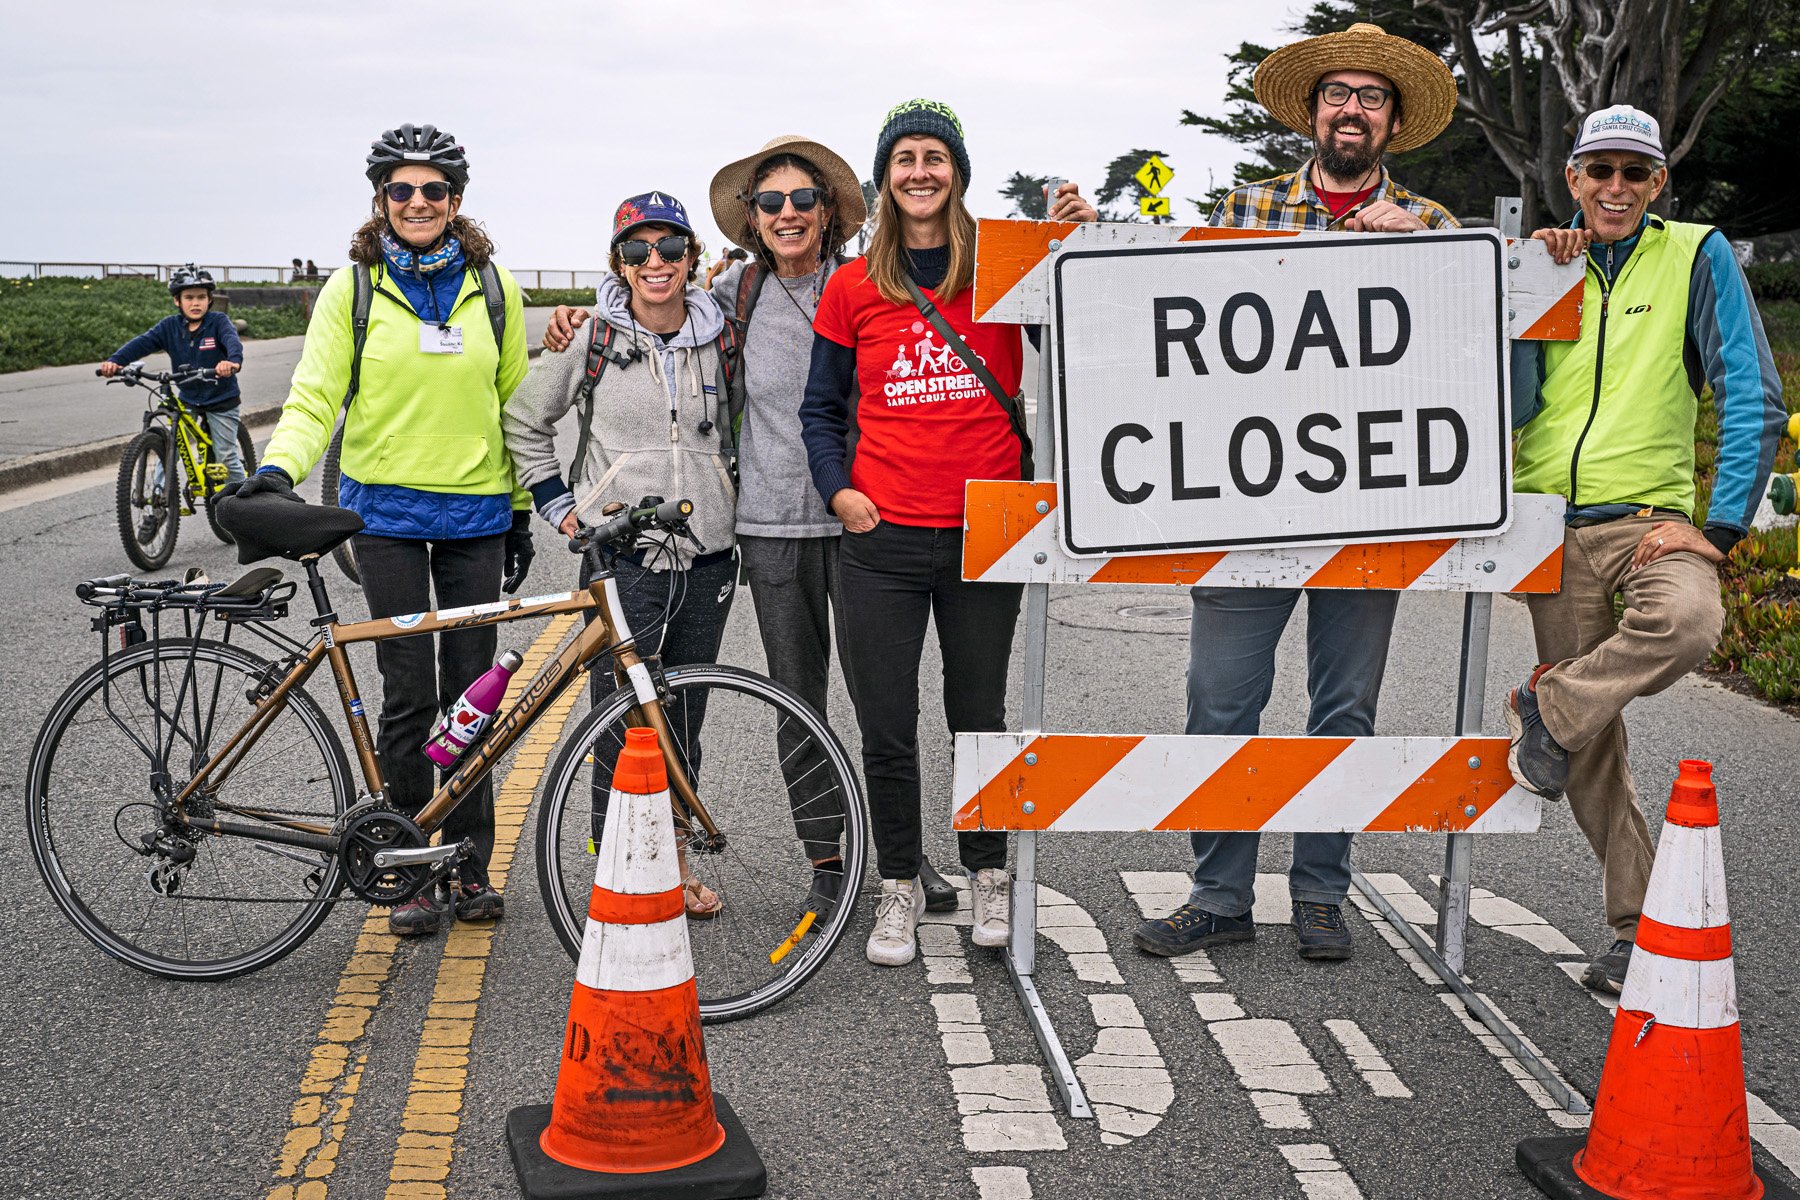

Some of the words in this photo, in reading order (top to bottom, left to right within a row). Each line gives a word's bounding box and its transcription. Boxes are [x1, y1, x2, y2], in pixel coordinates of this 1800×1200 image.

[1590, 127, 1600, 135] BIKE
[1602, 124, 1618, 132] SANTA
[1634, 127, 1652, 138] COUNTY
[1153, 286, 1411, 378] ROAD
[884, 379, 927, 397] OPEN
[887, 396, 917, 407] SANTA
[919, 392, 946, 404] CRUZ
[949, 388, 986, 401] COUNTY
[1100, 406, 1470, 505] CLOSED
[40, 796, 52, 850] ALEXRIMS
